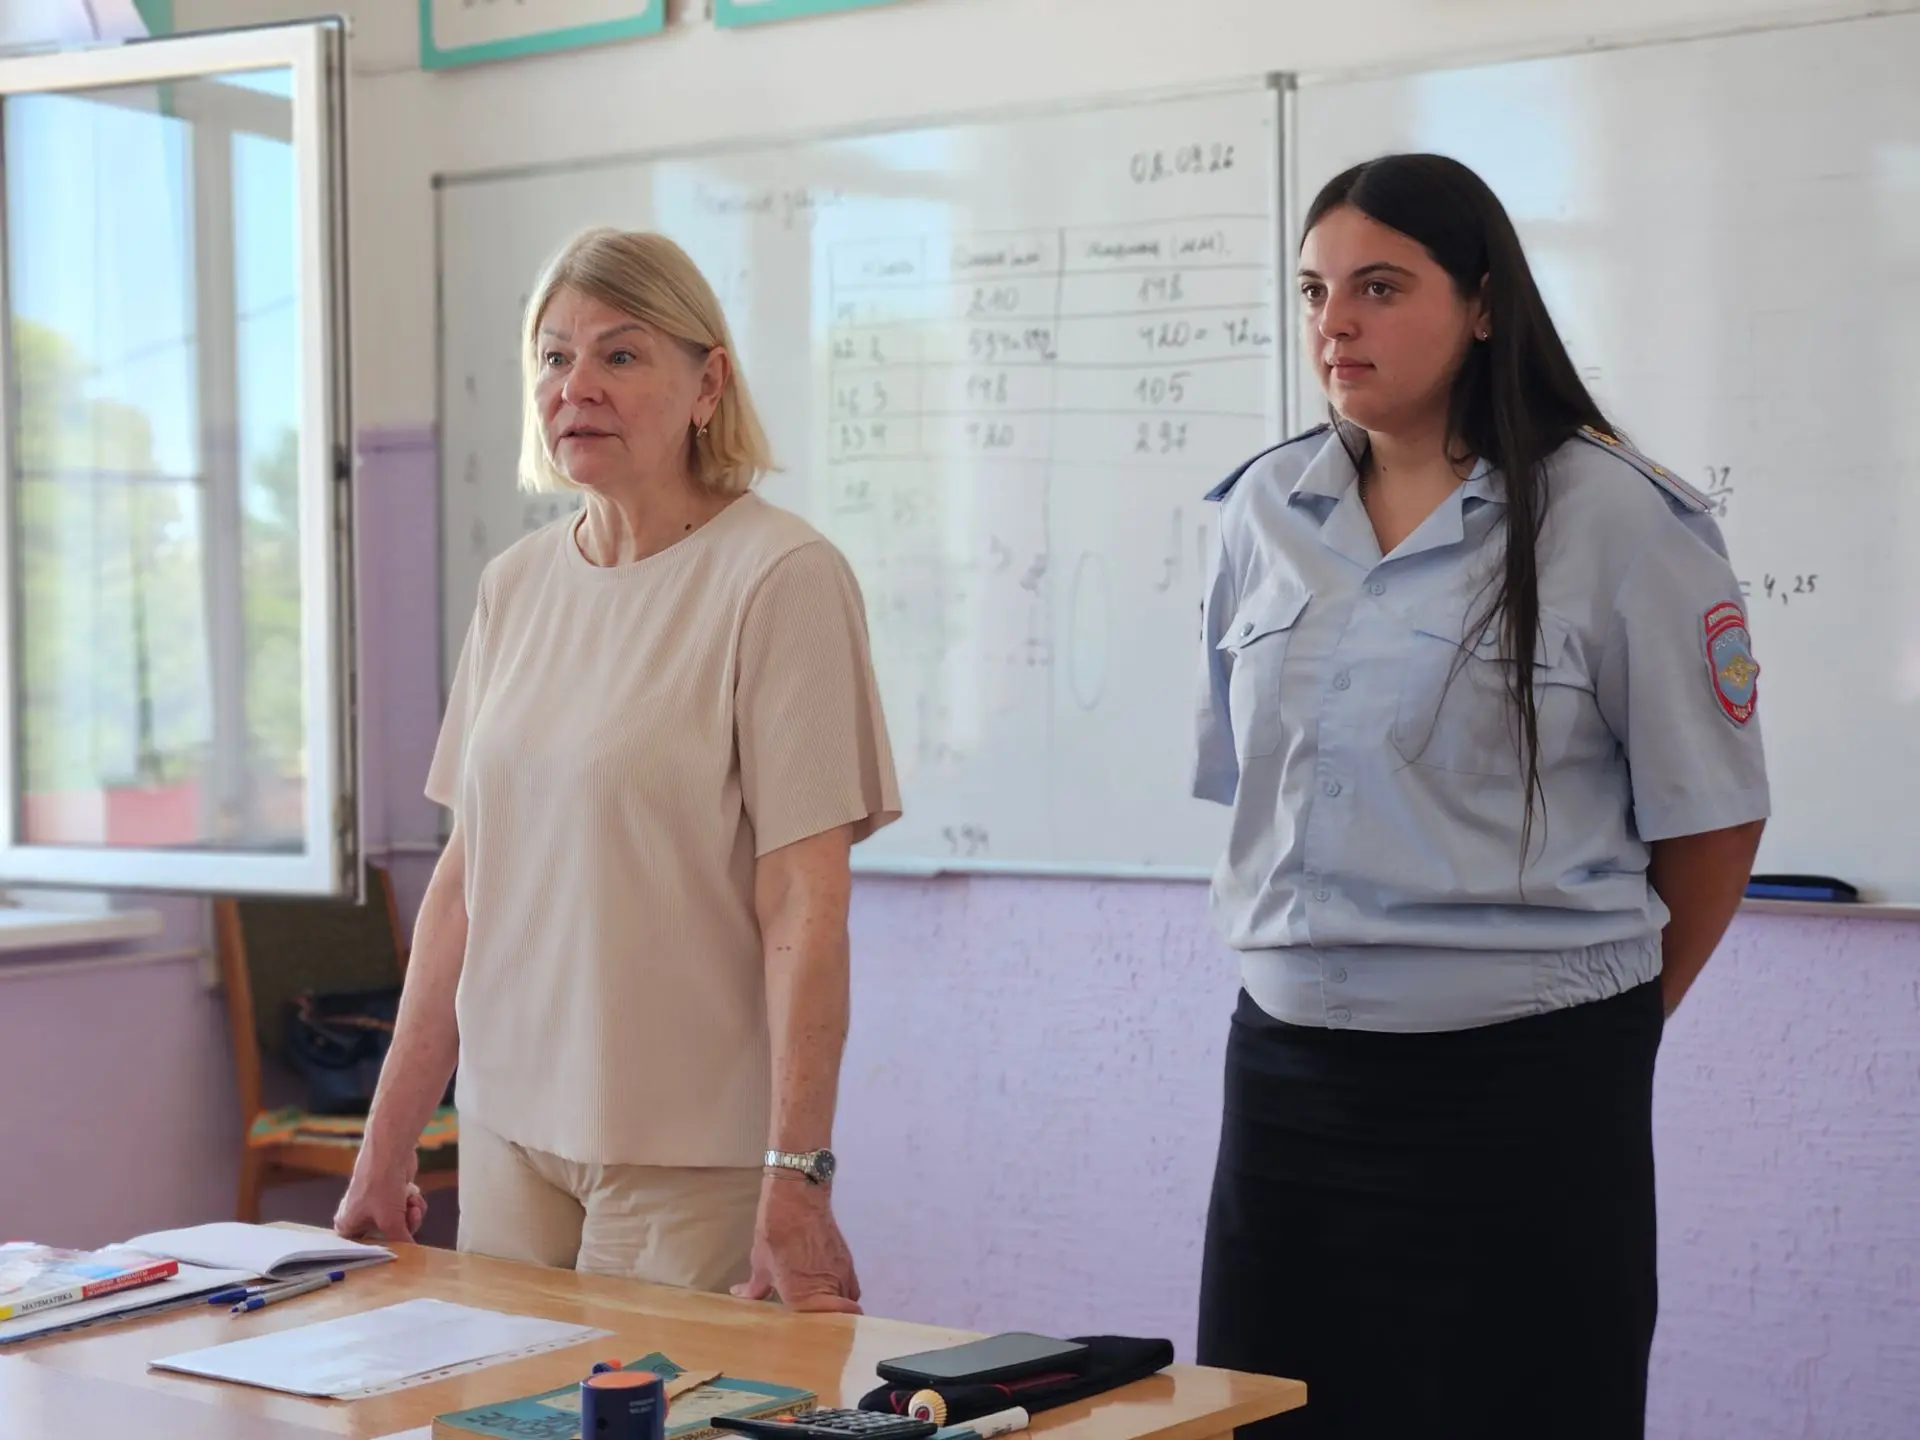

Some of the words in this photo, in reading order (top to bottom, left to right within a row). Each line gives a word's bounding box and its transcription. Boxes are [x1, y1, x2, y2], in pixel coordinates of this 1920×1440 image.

[1133, 371, 1191, 405] 105
[1764, 573, 1818, 605] 4,25
[21, 1291, 74, 1313] МАТЕМАТИКА
